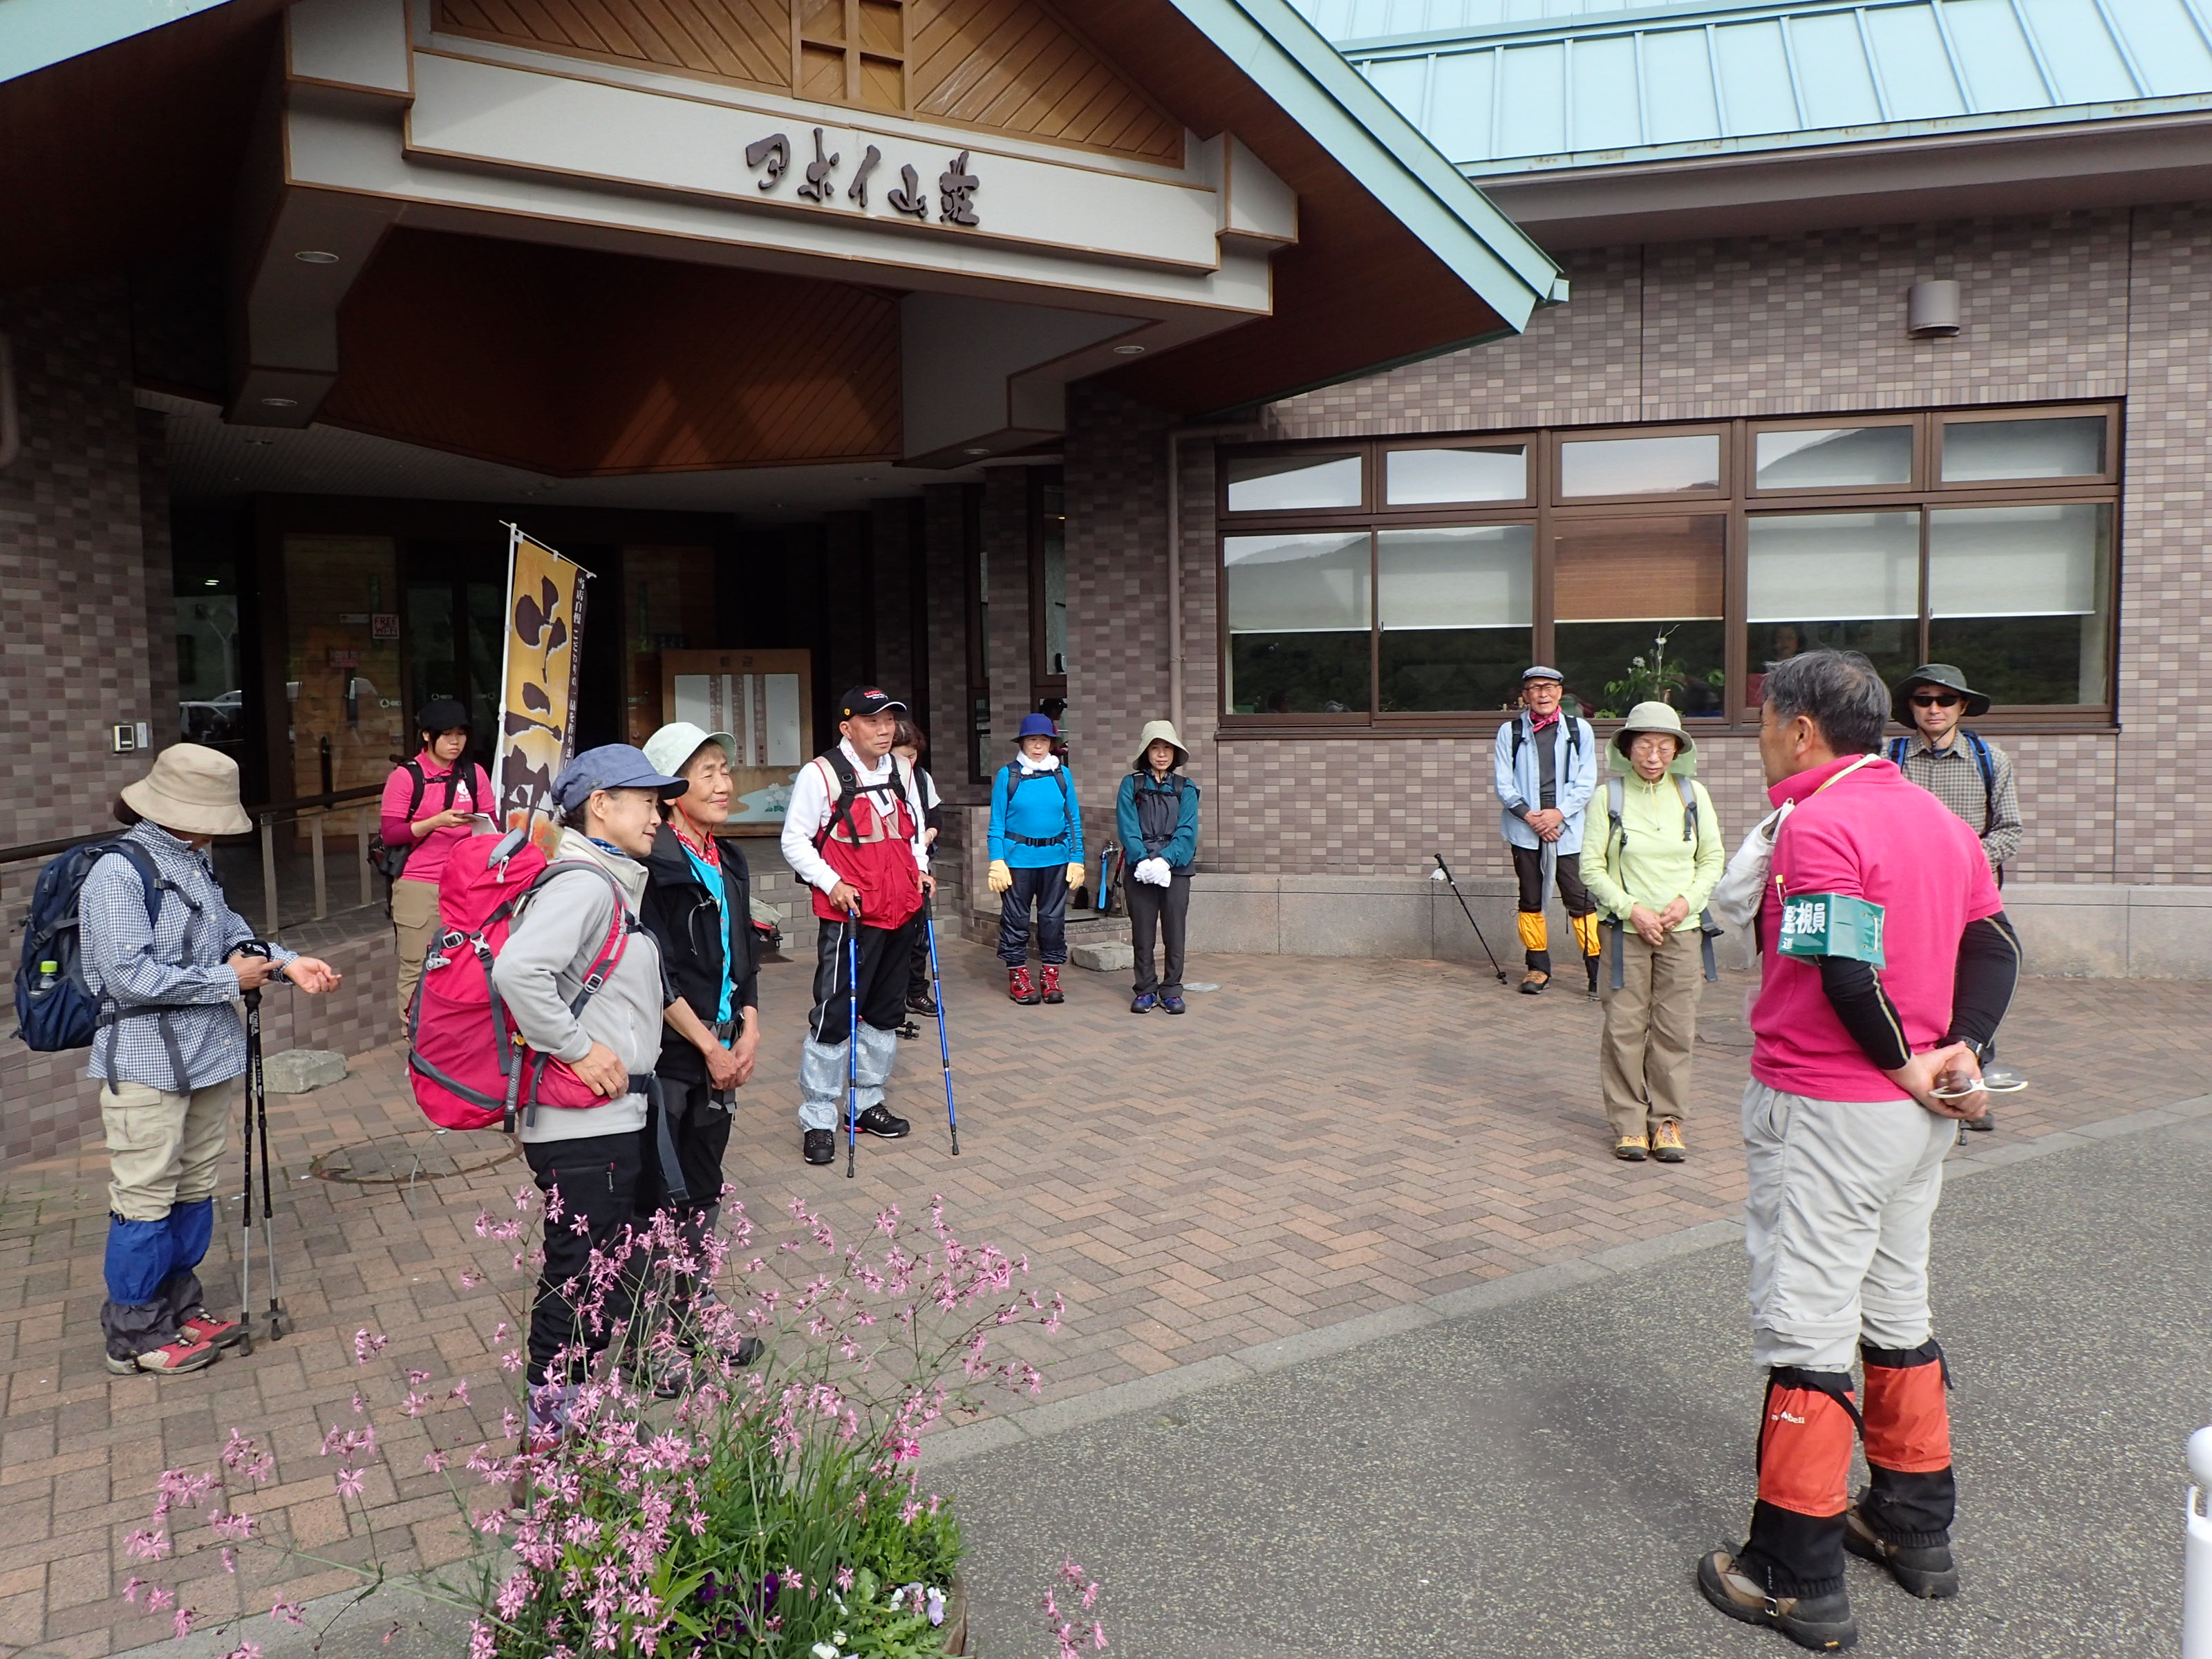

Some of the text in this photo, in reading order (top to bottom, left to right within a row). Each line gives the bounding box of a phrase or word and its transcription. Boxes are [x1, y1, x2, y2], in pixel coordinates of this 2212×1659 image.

[573, 577, 585, 625] 当店自慢
[375, 617, 397, 625] FREE
[1781, 902, 1826, 934] 監視員
[1781, 937, 1793, 950] 道
